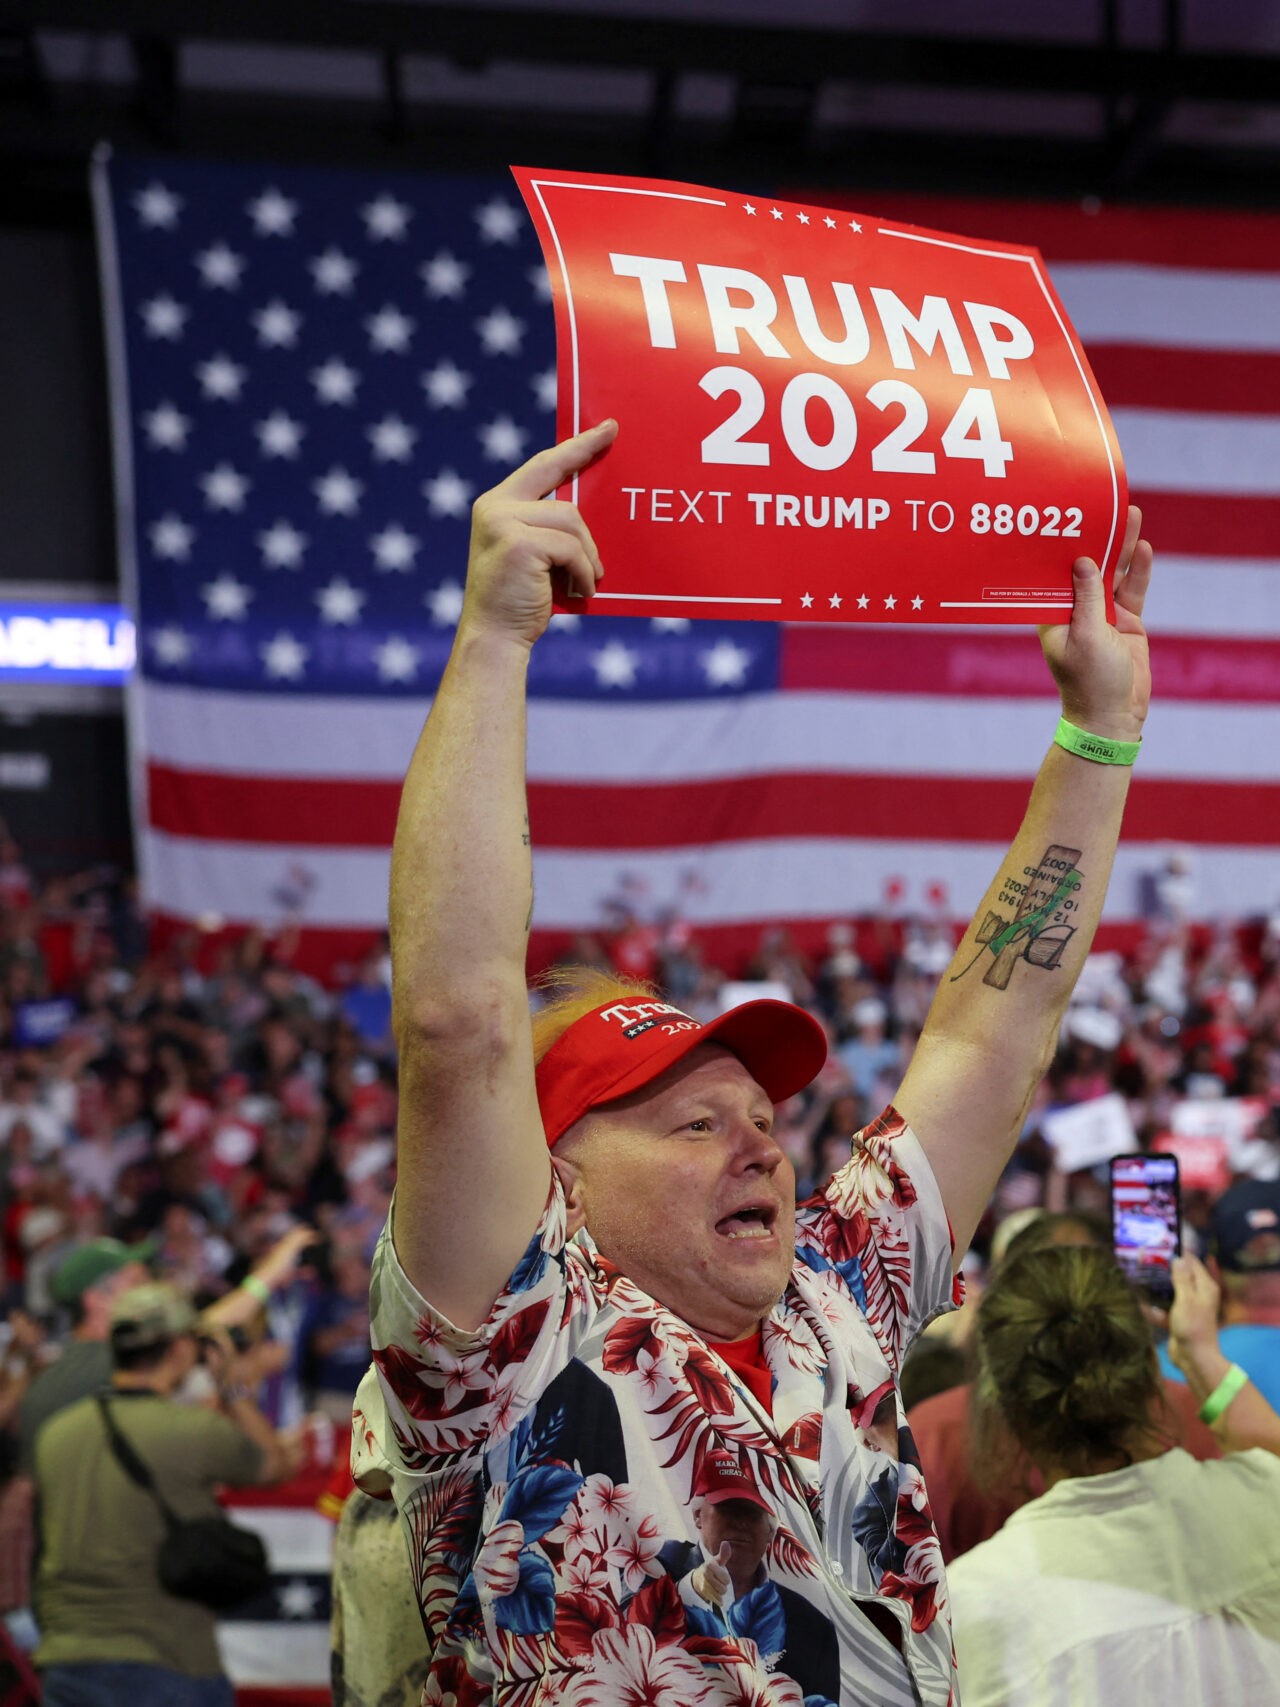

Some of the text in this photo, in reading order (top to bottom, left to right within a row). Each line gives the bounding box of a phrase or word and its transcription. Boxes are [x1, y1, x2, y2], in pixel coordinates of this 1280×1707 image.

[608, 252, 1035, 380] TRUMP
[698, 365, 1014, 478] 2024
[621, 487, 1084, 538] TEXT TRUMP TO 88022
[1080, 743, 1114, 757] TRUMP
[998, 891, 1022, 908] 1943
[1064, 900, 1079, 912] 10
[1054, 912, 1069, 923] 12
